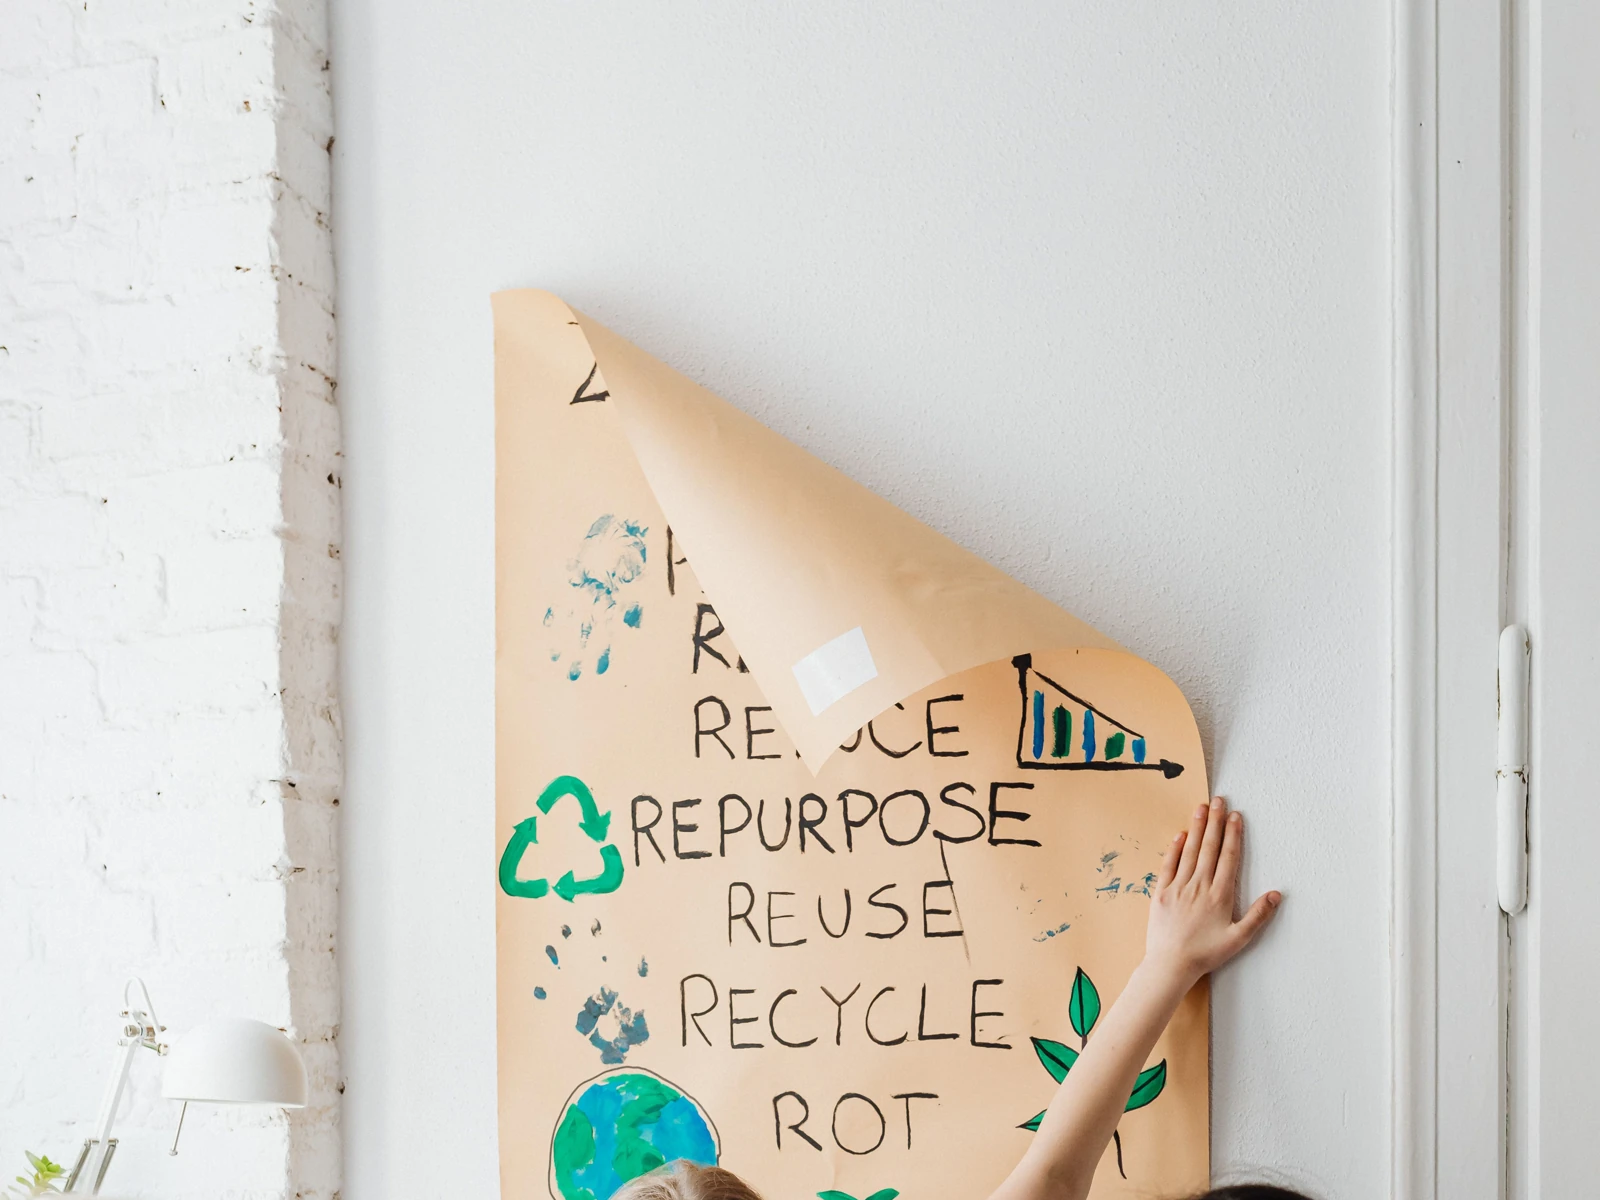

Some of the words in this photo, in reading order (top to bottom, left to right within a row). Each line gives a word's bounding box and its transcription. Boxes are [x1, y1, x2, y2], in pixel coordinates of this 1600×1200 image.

[693, 693, 970, 760] RECE
[631, 781, 1043, 867] REPURPOSE
[728, 880, 964, 948] REUSE
[680, 973, 1013, 1051] RECYCLE
[772, 1091, 939, 1155] ROT
